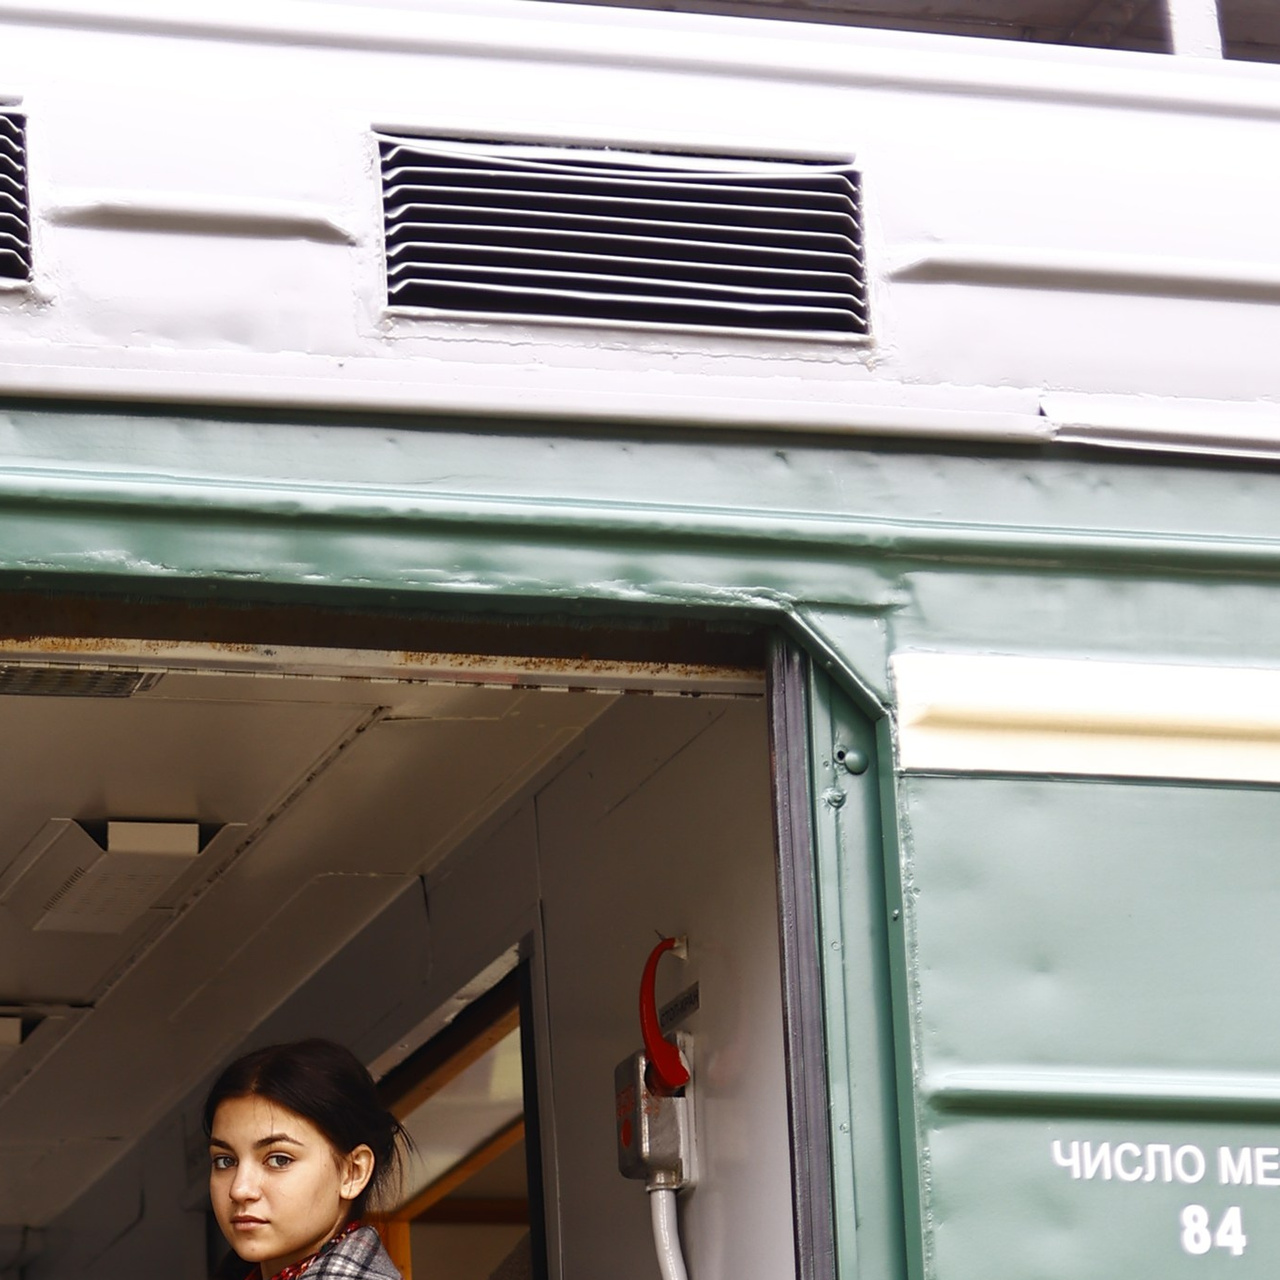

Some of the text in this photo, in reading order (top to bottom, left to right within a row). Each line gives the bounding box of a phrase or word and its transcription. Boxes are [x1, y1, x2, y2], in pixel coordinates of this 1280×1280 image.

[1052, 1140, 1280, 1186] ЧИСЛО МЕ
[1181, 1204, 1247, 1256] 84
